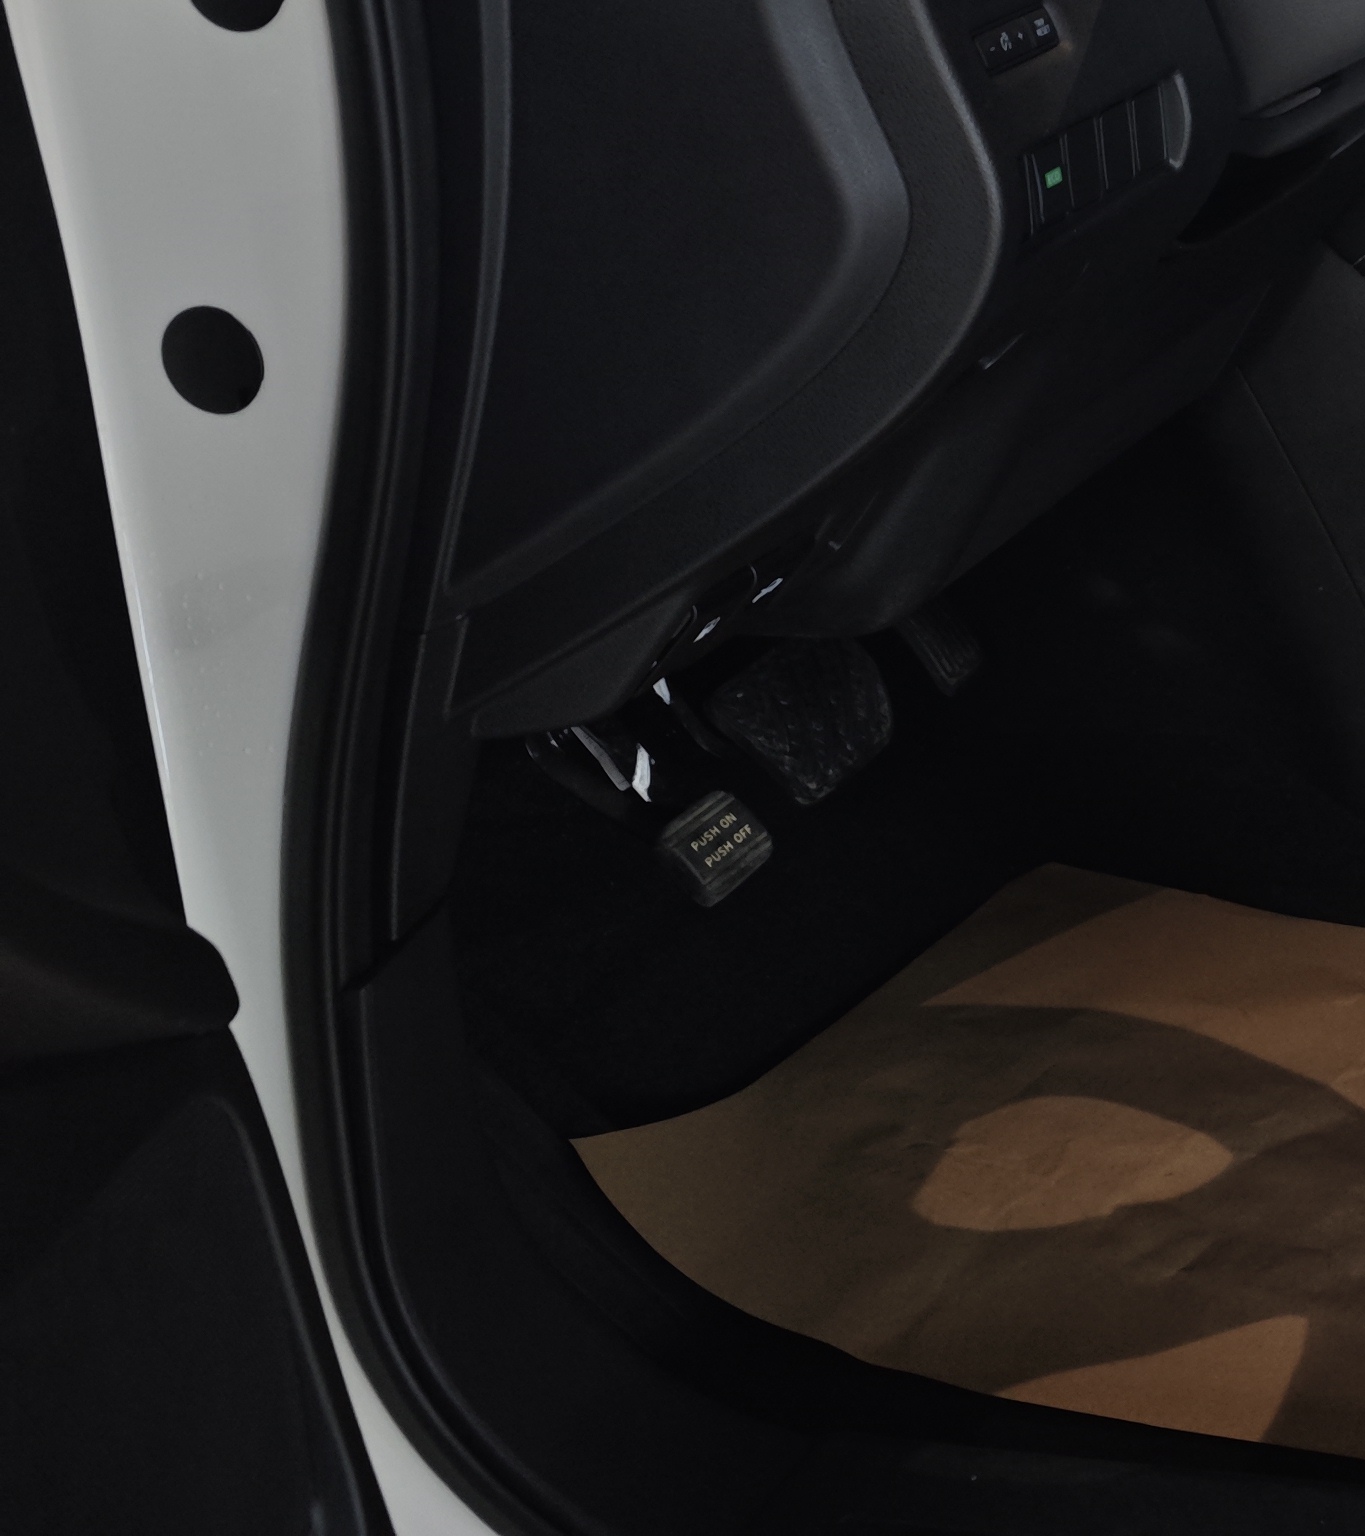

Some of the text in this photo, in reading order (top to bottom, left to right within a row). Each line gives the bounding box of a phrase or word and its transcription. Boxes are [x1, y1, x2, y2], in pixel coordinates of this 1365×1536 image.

[690, 812, 738, 852] PUSH ON
[704, 824, 752, 868] PUSH OFF
